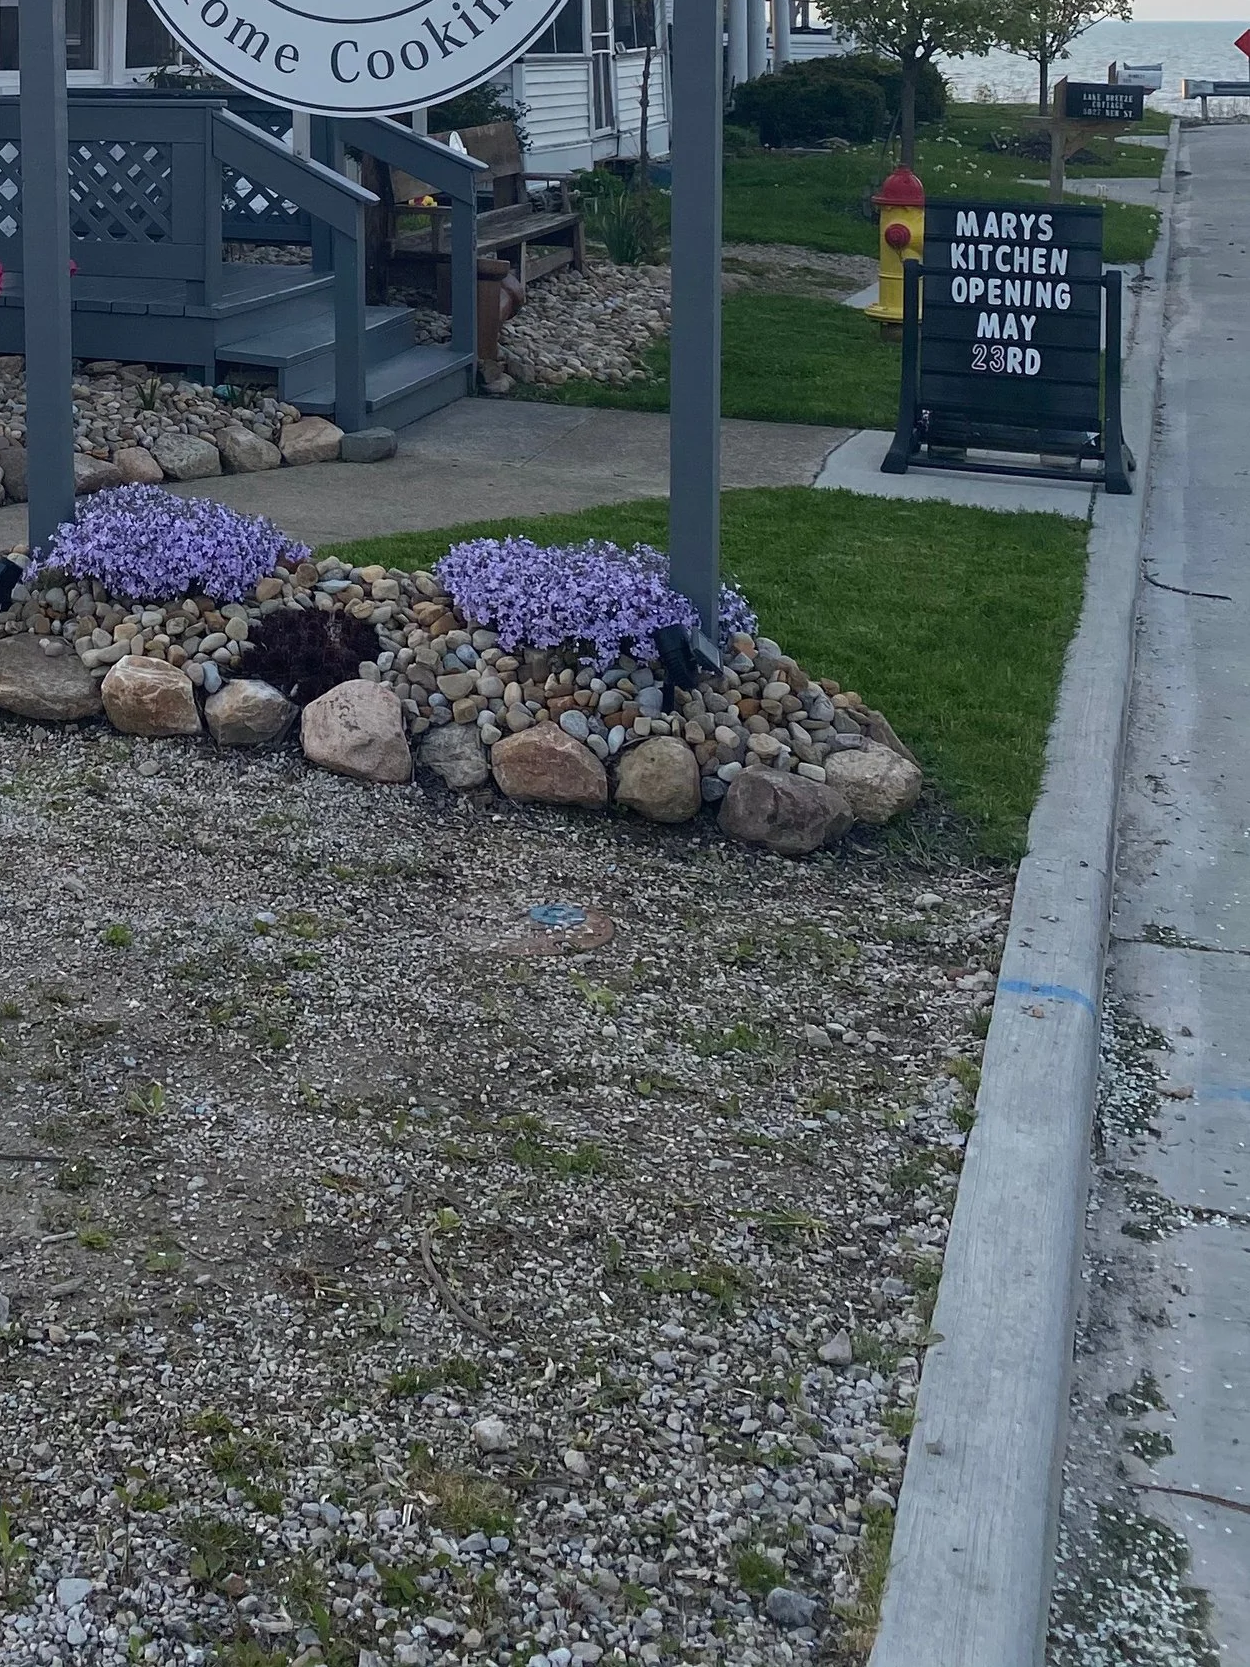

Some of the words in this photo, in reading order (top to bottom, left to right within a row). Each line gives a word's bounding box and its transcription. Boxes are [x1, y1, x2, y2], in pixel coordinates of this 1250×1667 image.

[1083, 93, 1102, 101] LAKE
[956, 211, 1054, 241] MARYS
[950, 242, 1068, 276] KITCHEN
[951, 276, 1071, 310] OPENING
[976, 312, 1037, 341] MAY
[971, 343, 1041, 376] 23RD
